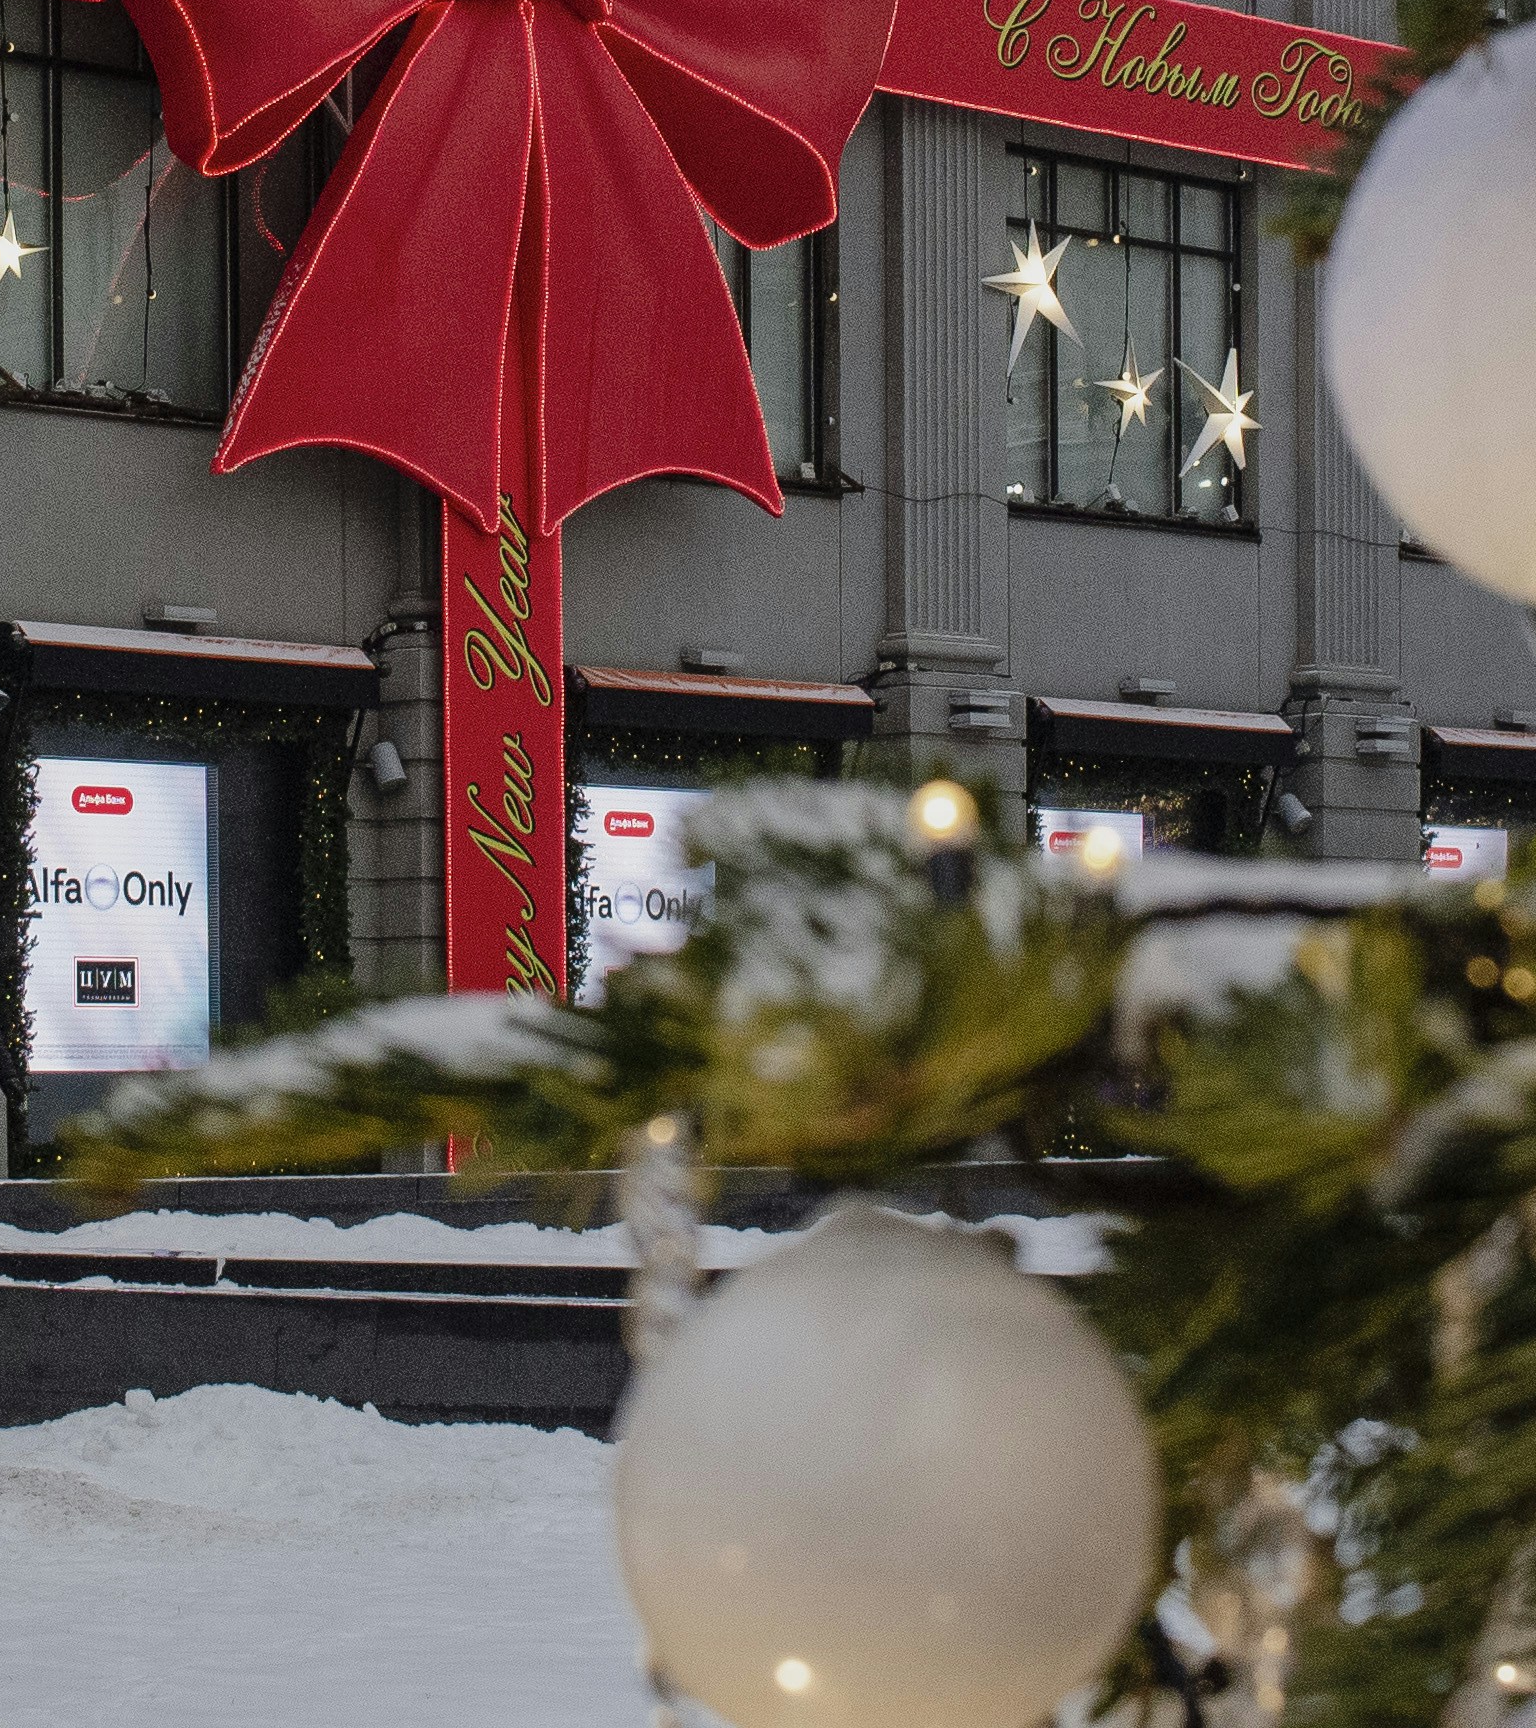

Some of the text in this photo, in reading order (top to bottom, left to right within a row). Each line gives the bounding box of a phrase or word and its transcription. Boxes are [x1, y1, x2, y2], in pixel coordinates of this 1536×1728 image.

[1251, 37, 1364, 128] Годо
[464, 492, 554, 708] Year
[122, 870, 192, 916] Only
[466, 730, 538, 922] New
